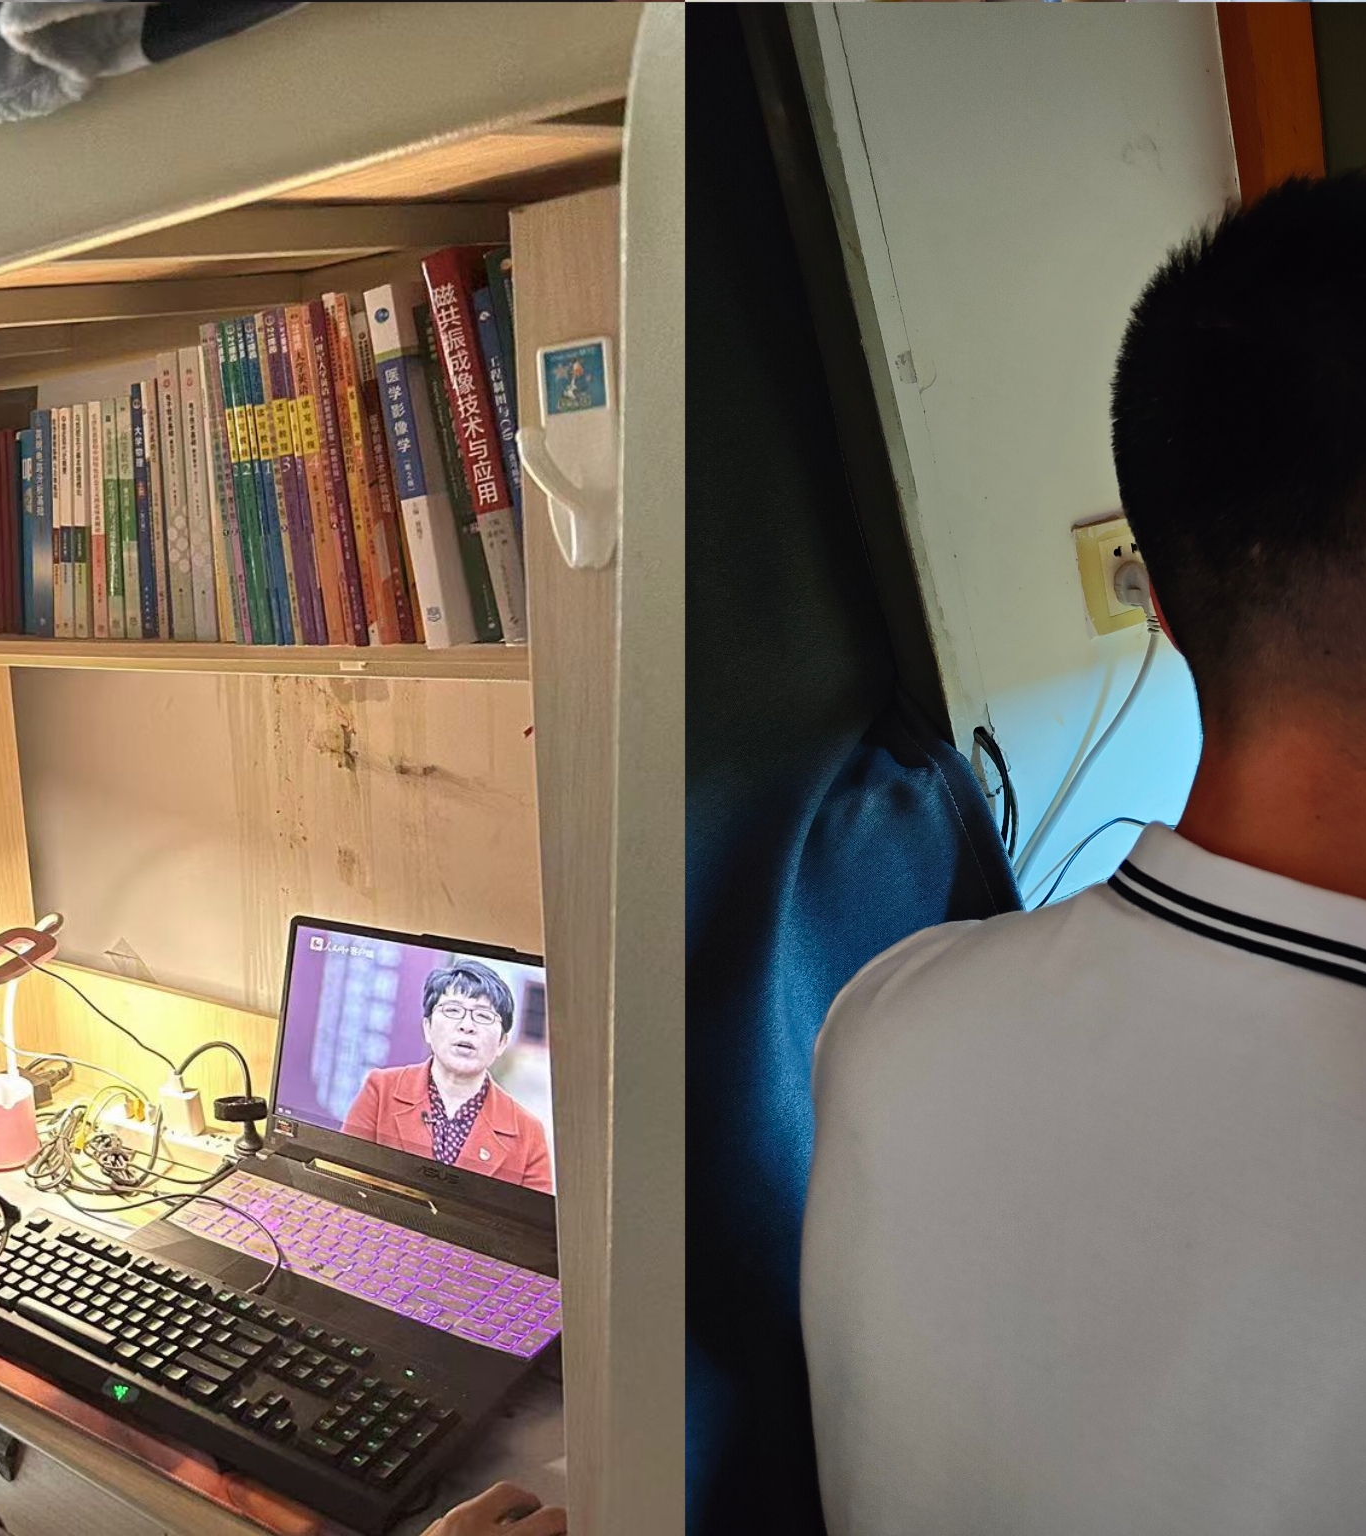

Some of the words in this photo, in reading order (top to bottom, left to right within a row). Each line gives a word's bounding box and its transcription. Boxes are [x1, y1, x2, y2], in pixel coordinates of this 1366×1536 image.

[384, 367, 412, 453] 医学影像学
[433, 282, 500, 507] 磁共振成像技术与应用
[134, 426, 144, 468] 大学物理
